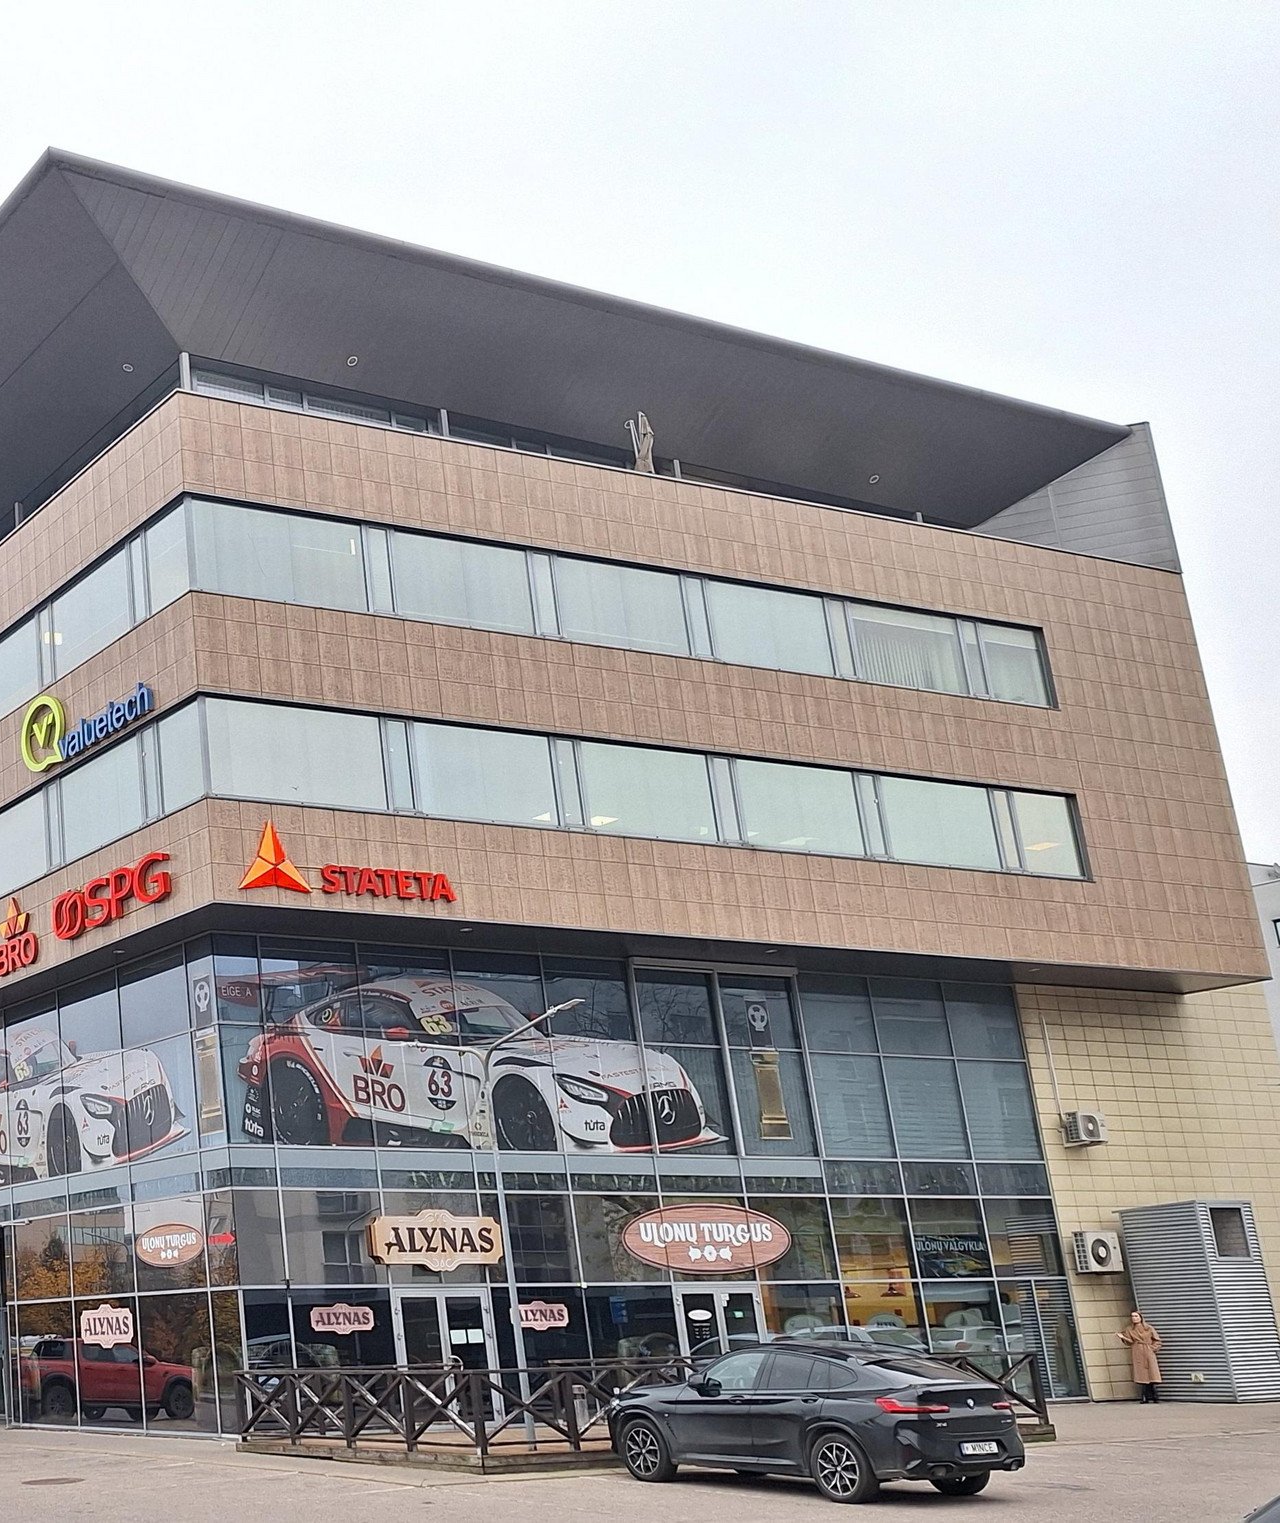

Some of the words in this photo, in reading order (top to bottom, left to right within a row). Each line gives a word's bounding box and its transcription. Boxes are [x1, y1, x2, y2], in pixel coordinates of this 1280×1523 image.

[58, 682, 153, 760] valuetech
[84, 852, 172, 928] SPG
[321, 863, 458, 902] STATETA
[421, 984, 481, 997] STAETA
[420, 1014, 454, 1036] 63
[353, 1074, 406, 1112] BRO
[427, 1068, 453, 1098] 63
[17, 1111, 29, 1136] 63
[165, 1232, 197, 1250] TURGUS
[384, 1226, 495, 1256] ALYNAS
[700, 1222, 773, 1247] TURGUS
[944, 1240, 984, 1252] VALGYKLA
[84, 1315, 130, 1337] ALYNAS
[314, 1310, 371, 1328] ALYNAS
